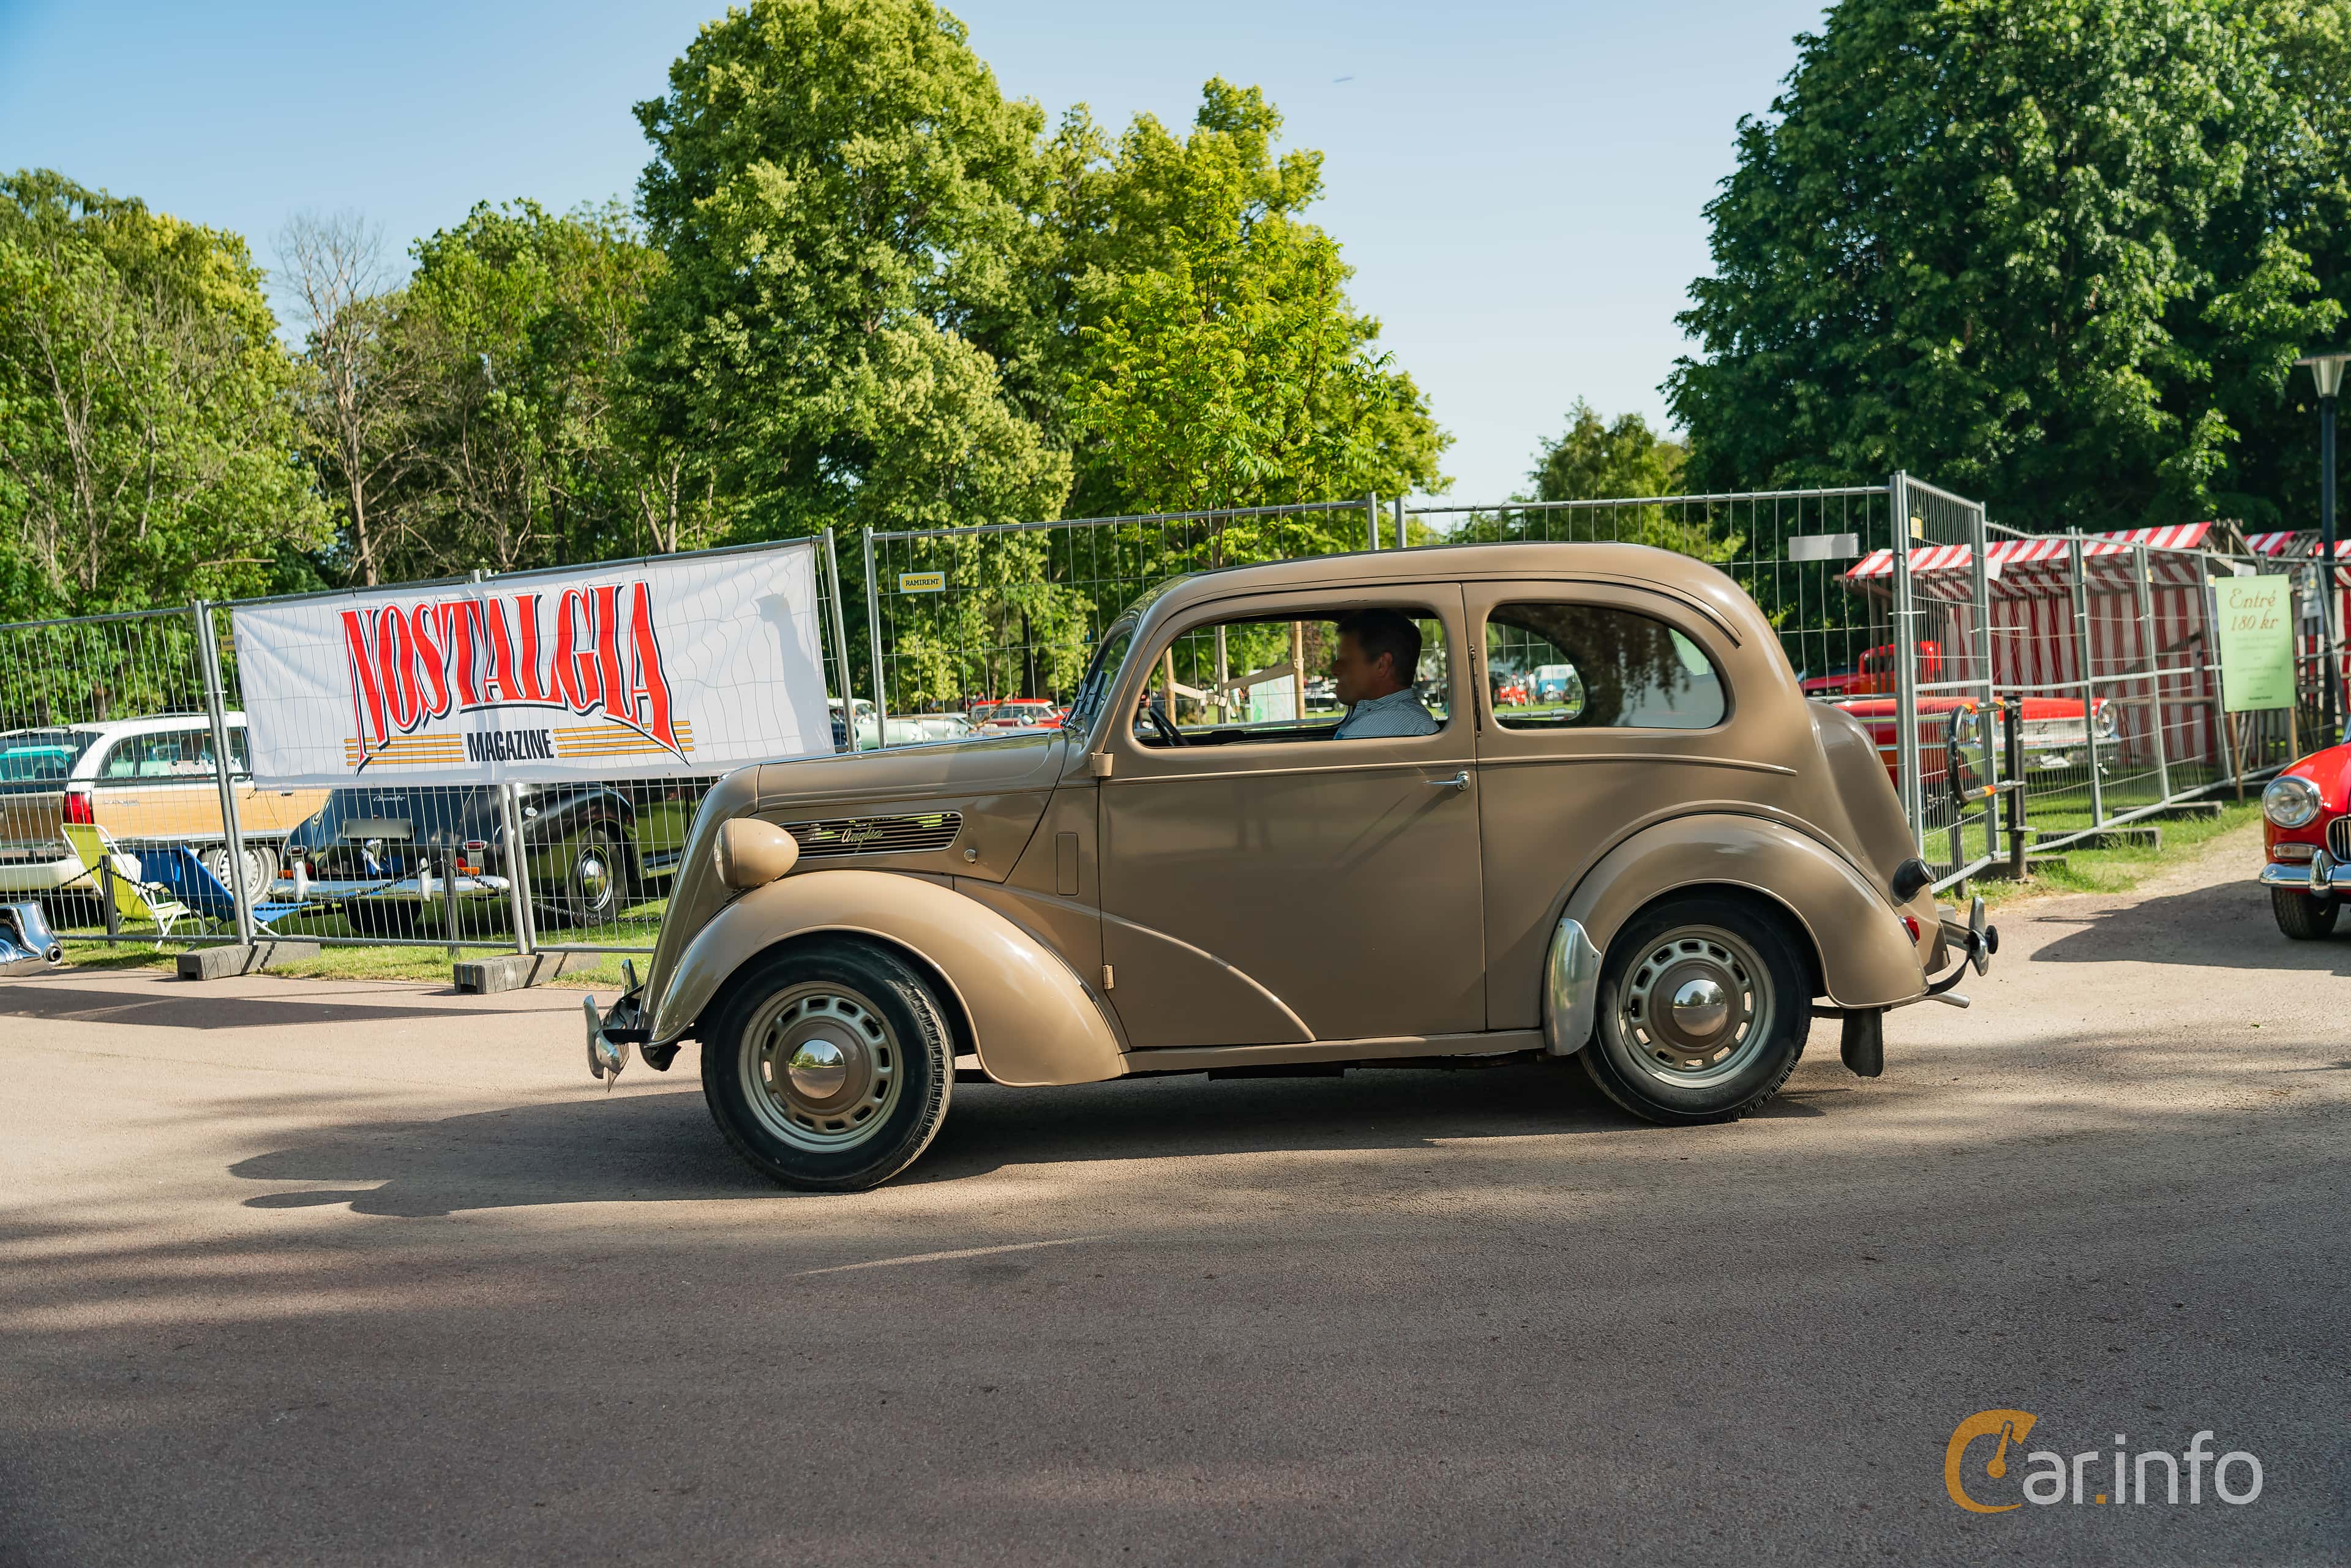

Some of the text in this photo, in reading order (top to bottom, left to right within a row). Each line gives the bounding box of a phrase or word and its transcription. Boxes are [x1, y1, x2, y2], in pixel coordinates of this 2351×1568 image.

[2229, 587, 2276, 609] Entré
[2231, 609, 2279, 631] 180 kr
[339, 579, 691, 776] NOSTALGIA
[467, 729, 555, 762] MAGAZINE
